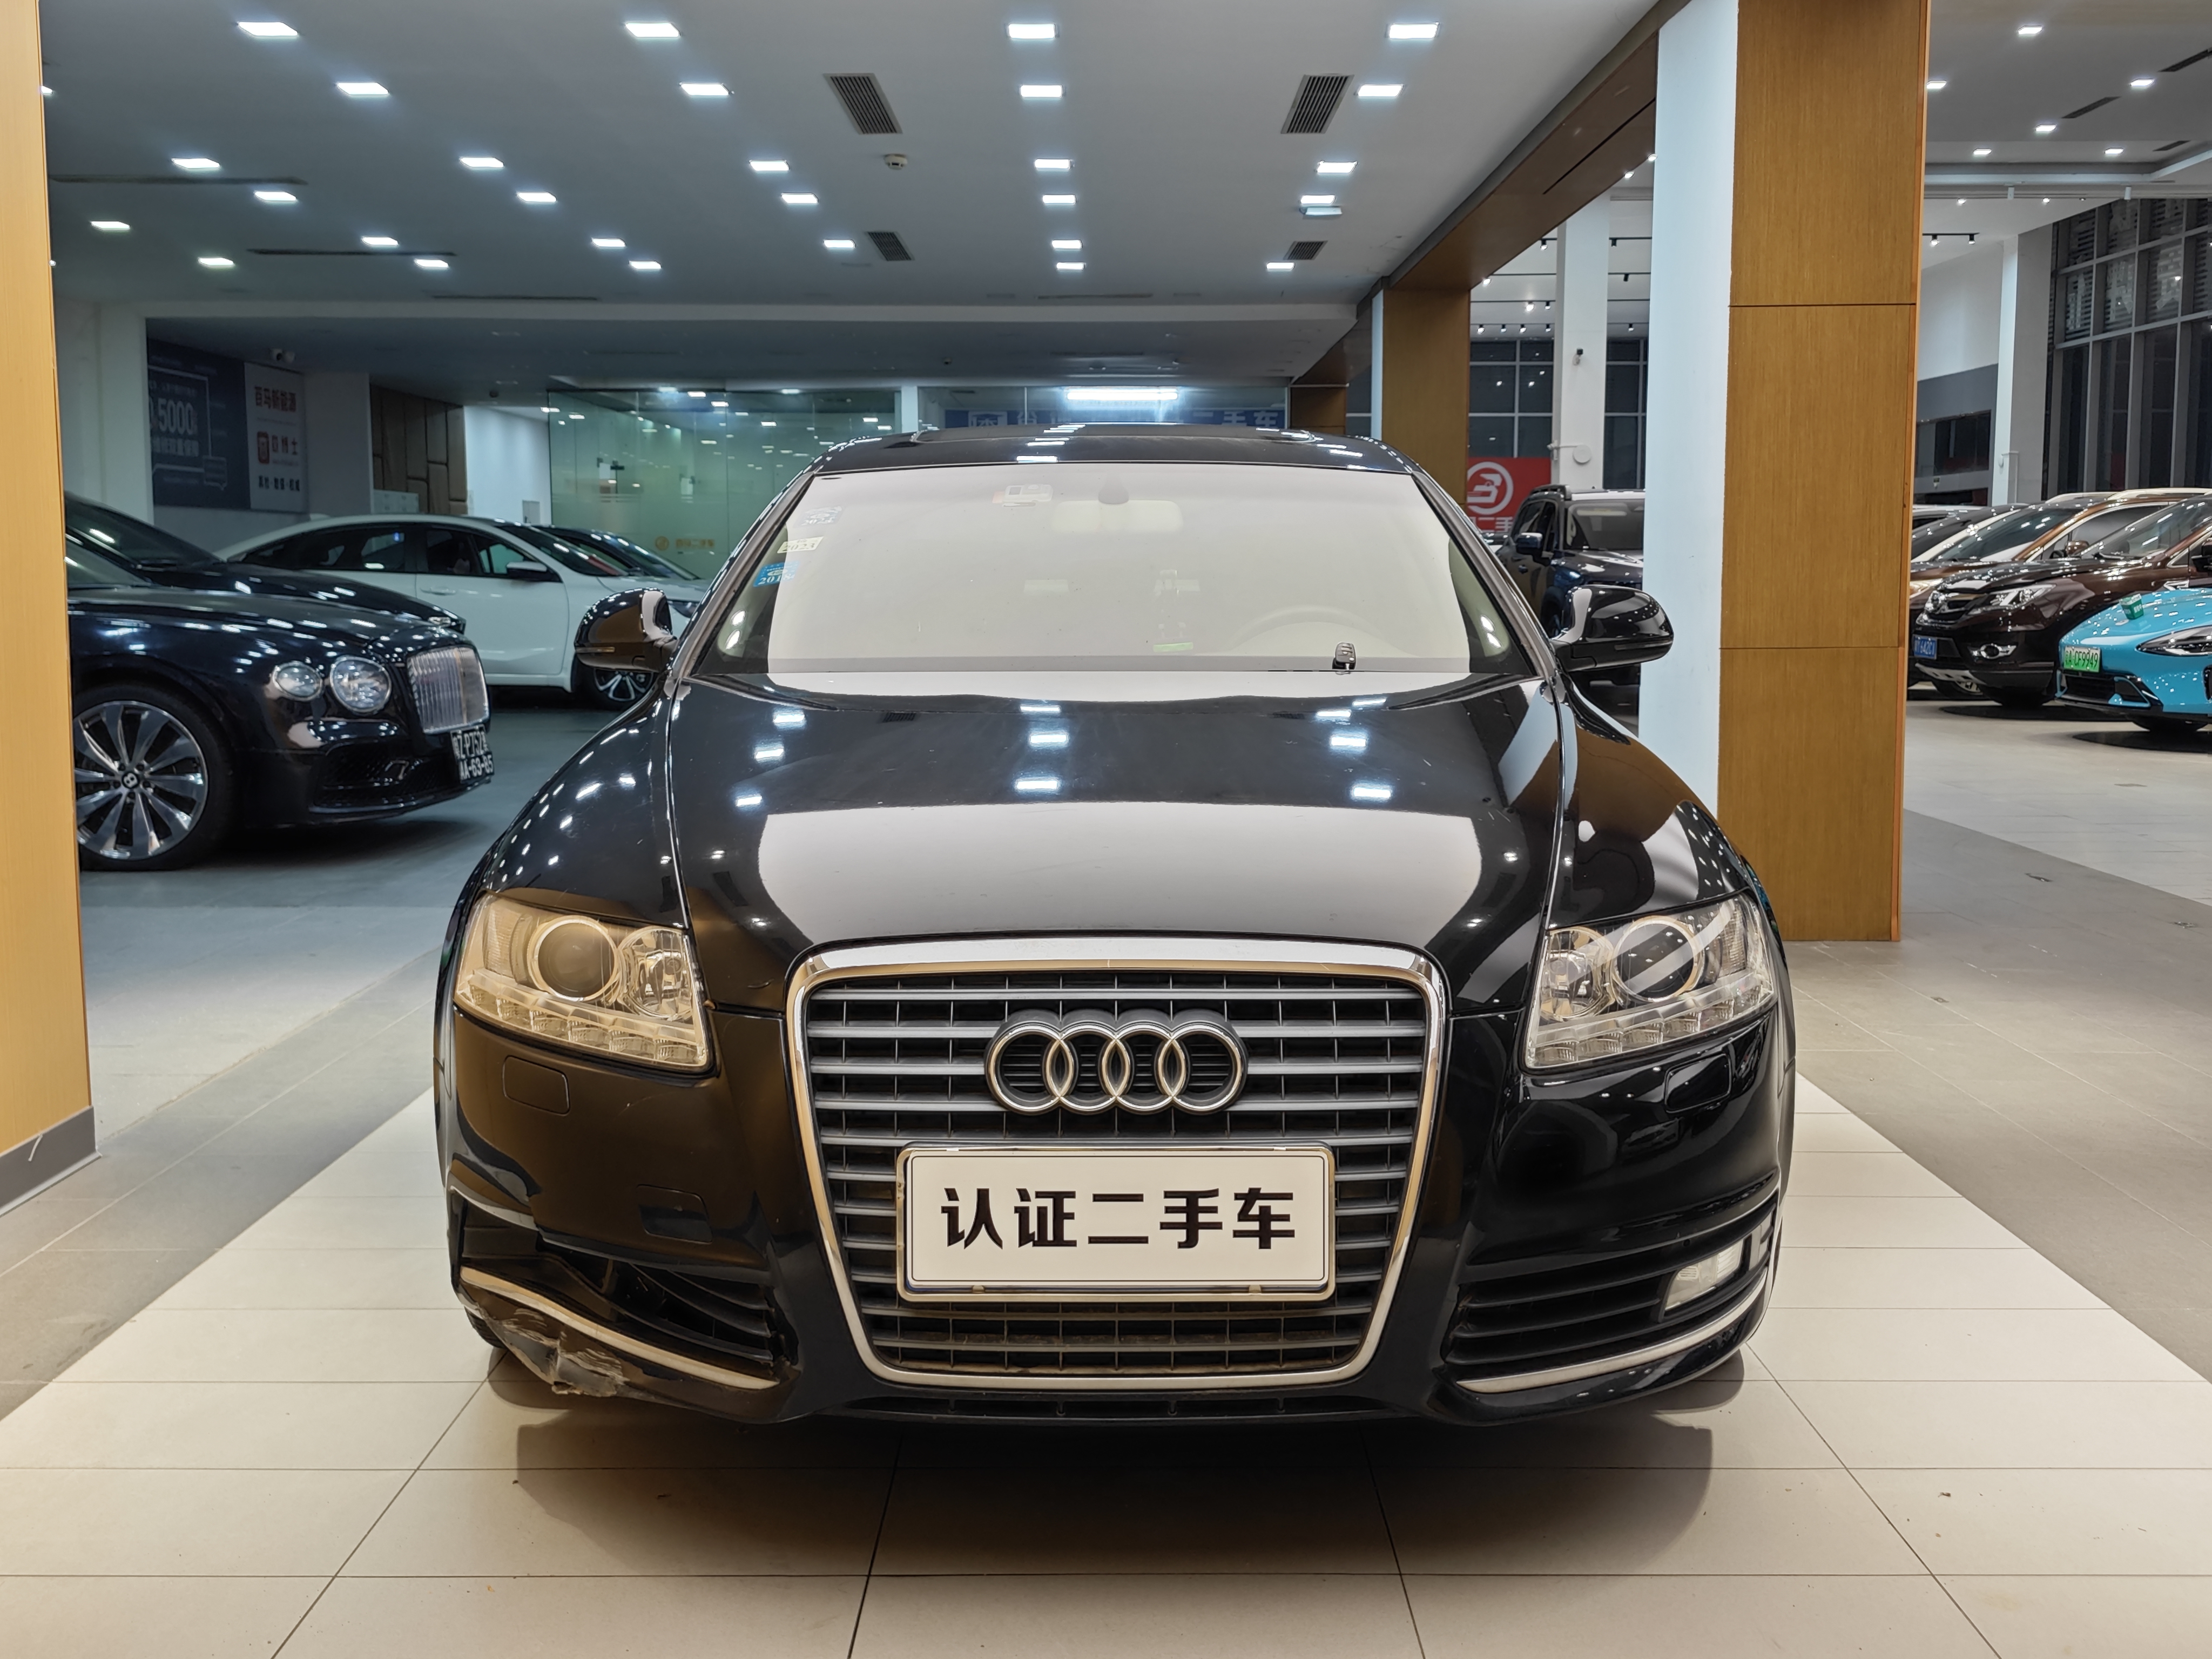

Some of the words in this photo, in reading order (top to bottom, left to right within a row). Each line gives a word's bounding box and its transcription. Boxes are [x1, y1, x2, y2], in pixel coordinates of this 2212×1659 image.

[782, 542, 815, 552] 2023
[940, 1187, 1296, 1250] 认证二手车
